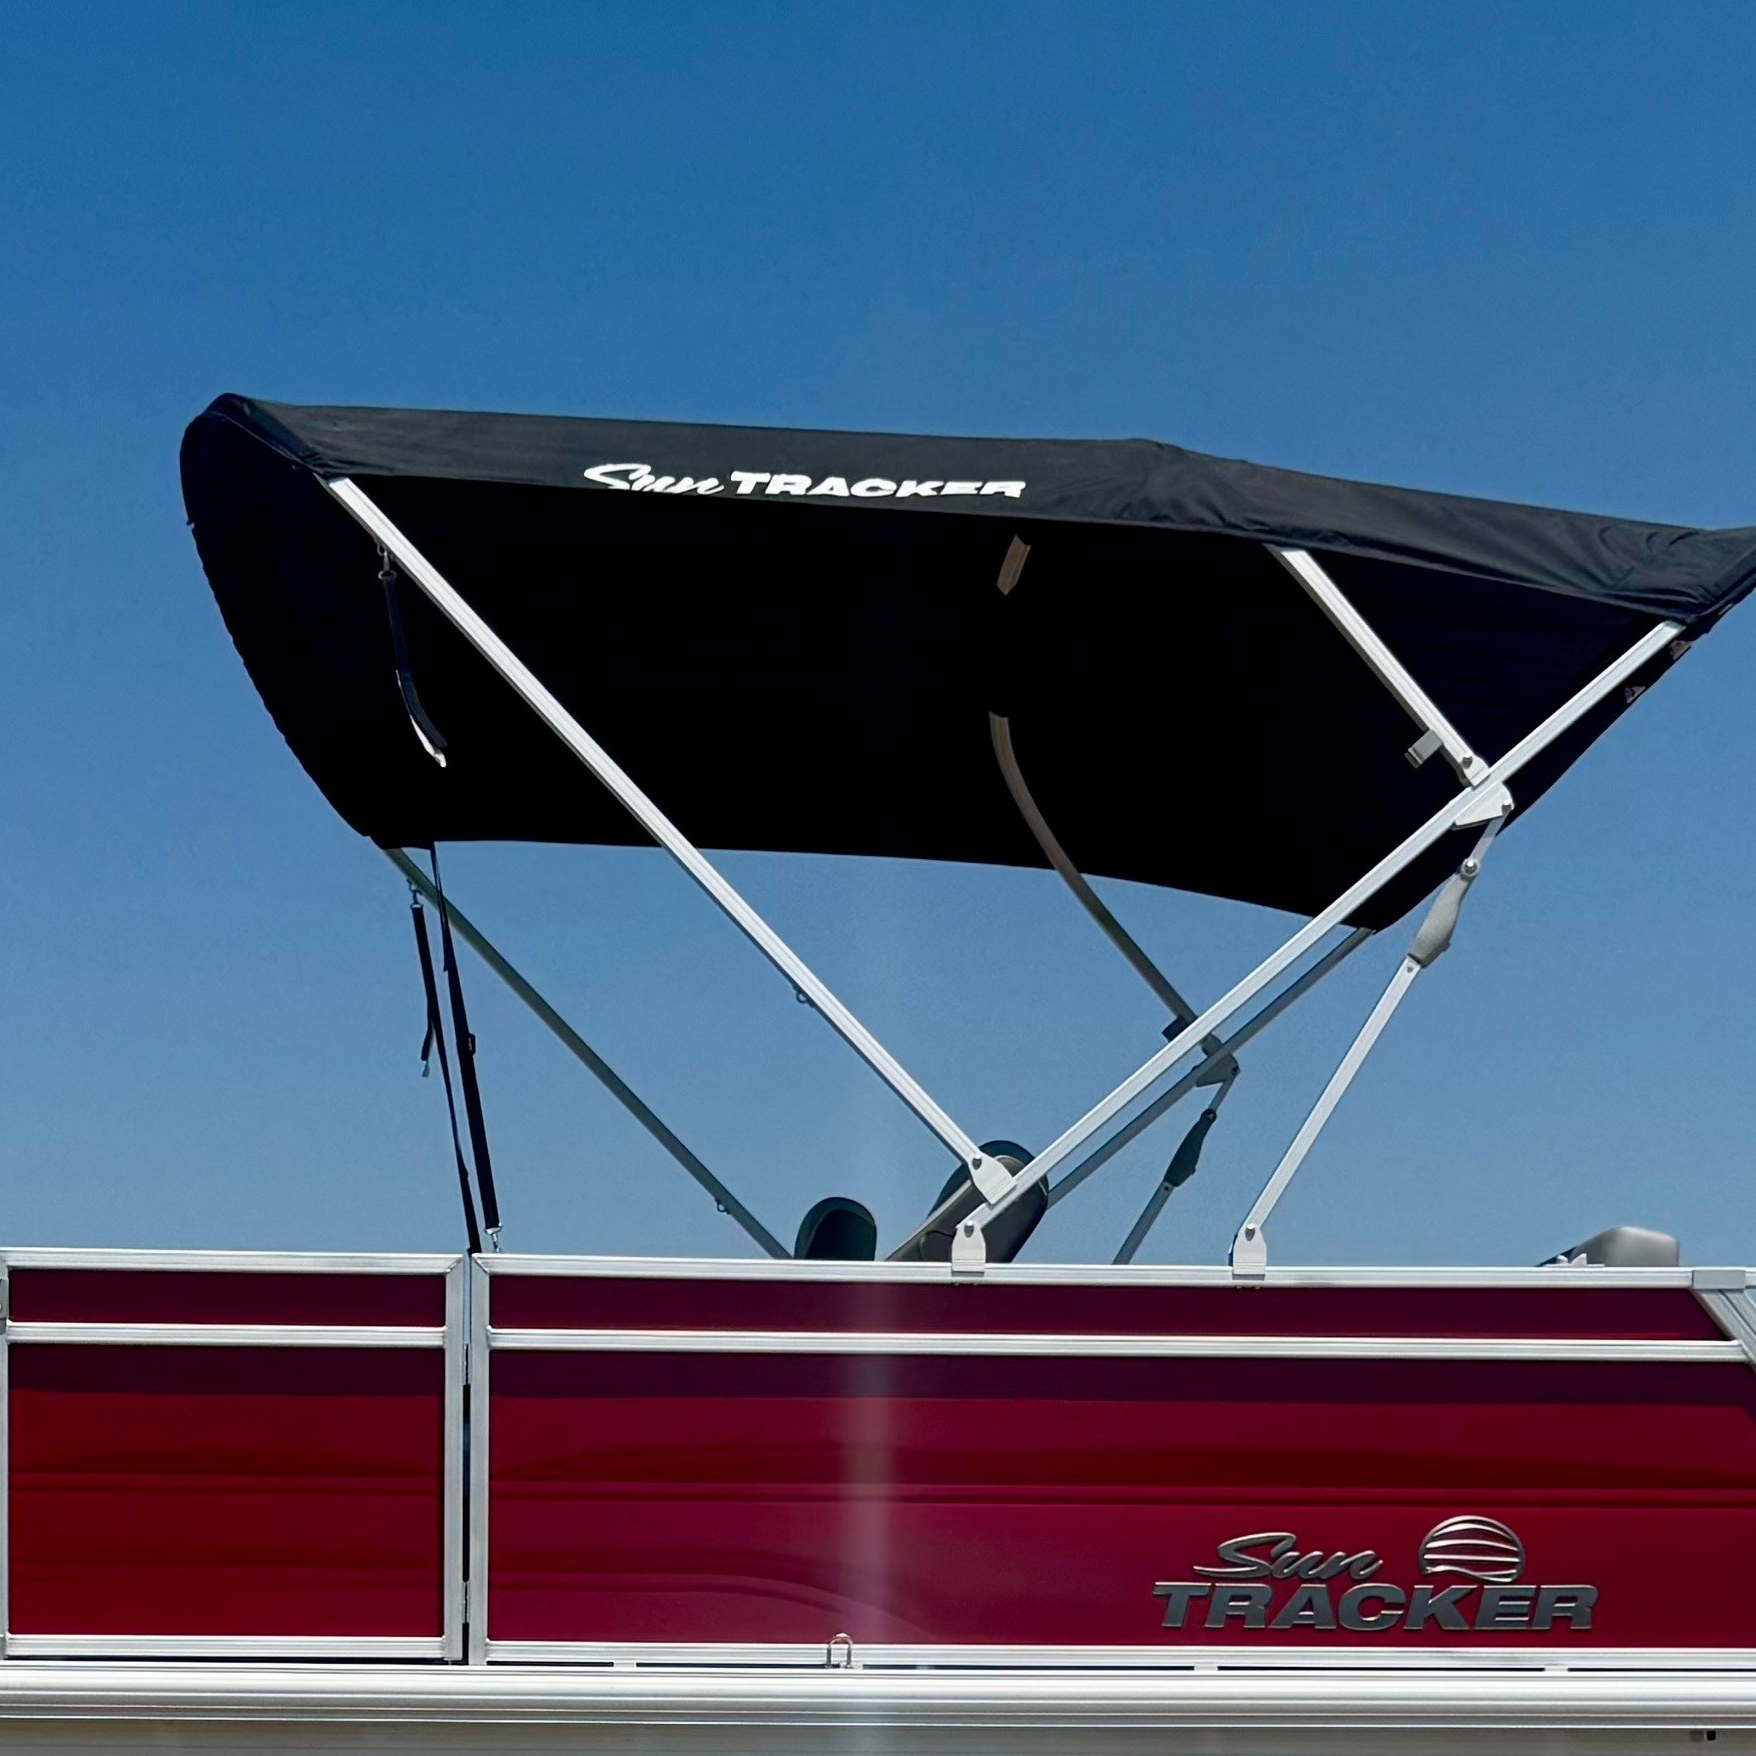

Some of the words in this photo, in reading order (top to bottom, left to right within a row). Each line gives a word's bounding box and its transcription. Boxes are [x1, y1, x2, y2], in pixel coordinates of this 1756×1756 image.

[584, 463, 725, 495] Sun
[730, 471, 1026, 498] TRACKER
[1193, 1532, 1383, 1580] Sun
[1153, 1581, 1599, 1631] TRACKER
